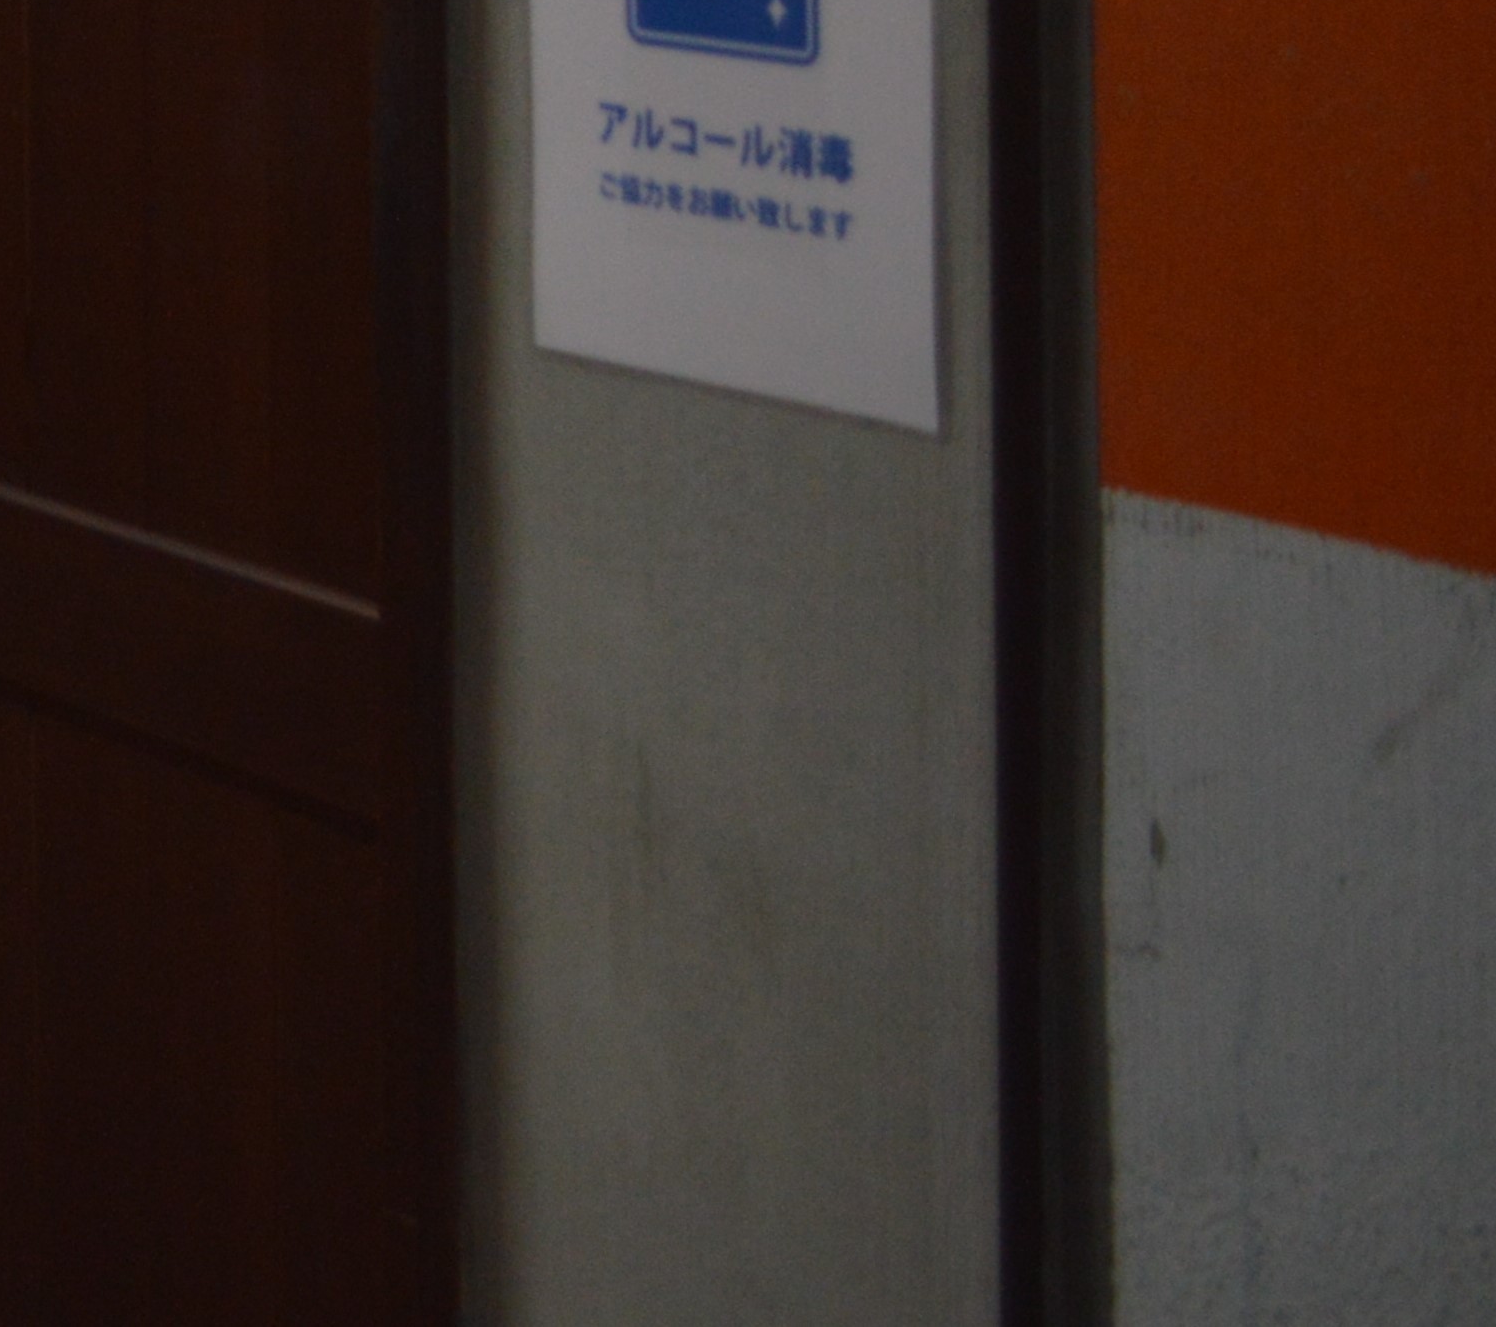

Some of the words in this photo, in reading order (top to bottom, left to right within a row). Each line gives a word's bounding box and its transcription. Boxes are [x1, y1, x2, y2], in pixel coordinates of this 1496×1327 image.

[598, 101, 854, 183] アルコール消毒
